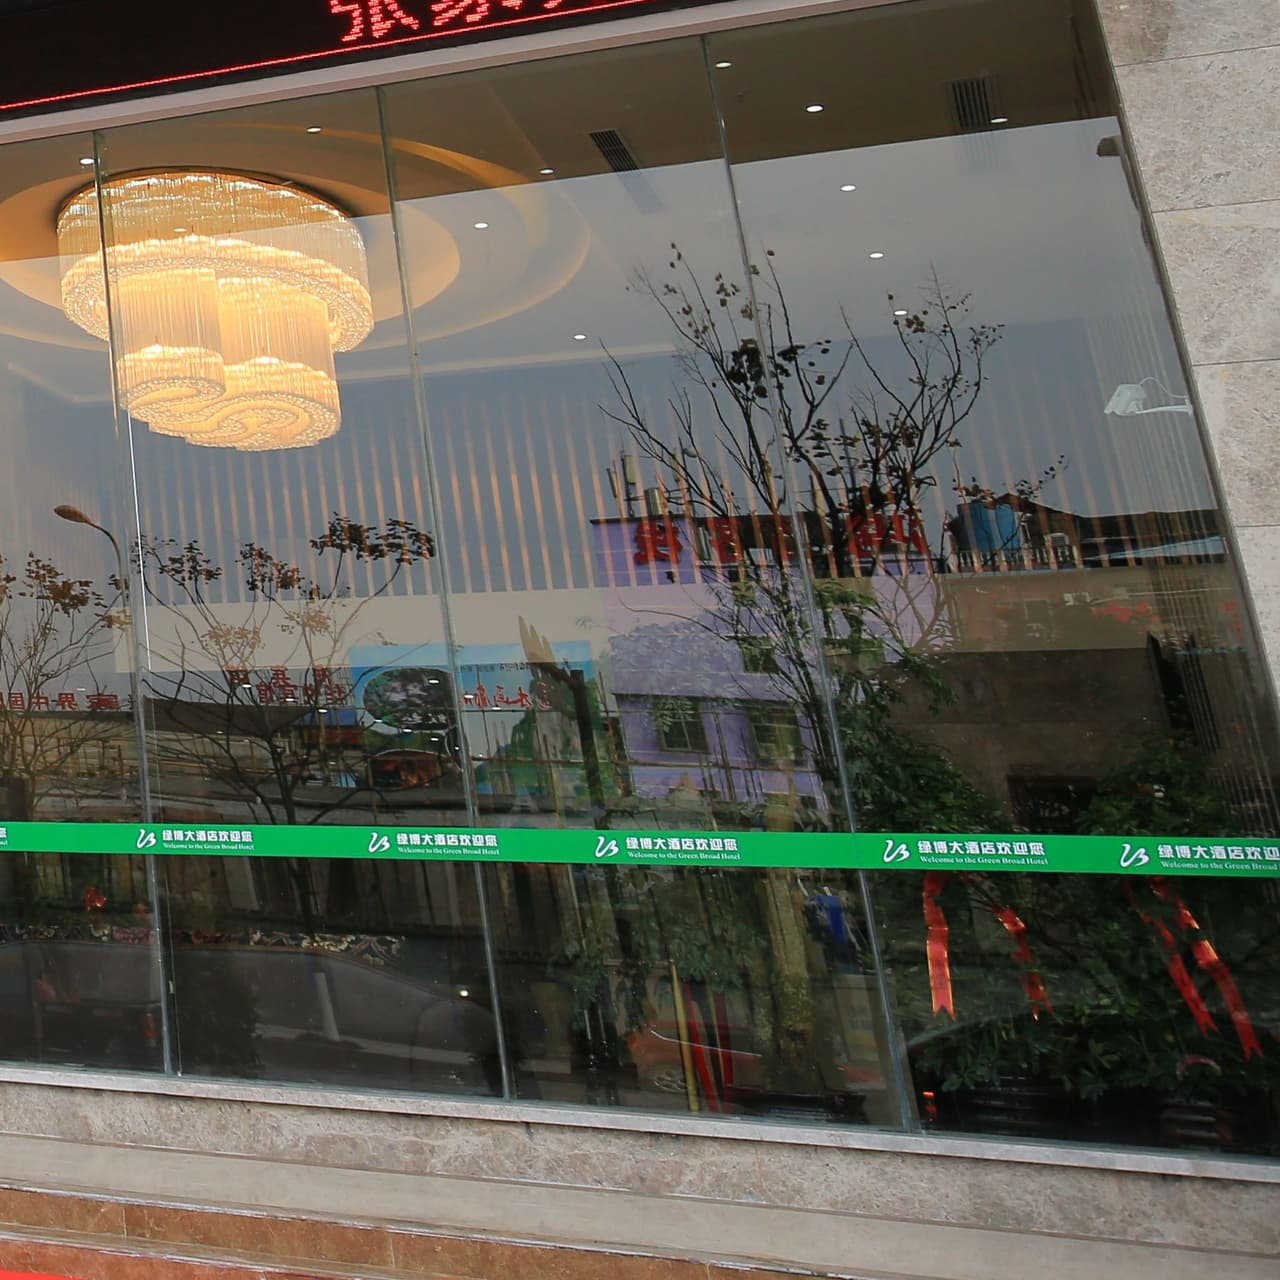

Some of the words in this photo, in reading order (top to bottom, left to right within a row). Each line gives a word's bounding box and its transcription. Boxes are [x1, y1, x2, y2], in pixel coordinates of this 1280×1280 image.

[163, 830, 252, 842] 绿博大酒店欢迎您
[397, 833, 497, 846] 绿博大酒店欢迎您
[626, 838, 737, 850] 绿博大酒店欢迎您
[918, 841, 1045, 855] 绿博大酒店欢迎您
[628, 851, 658, 859] Welcome
[1158, 845, 1280, 861] 绿博大酒店欢迎
